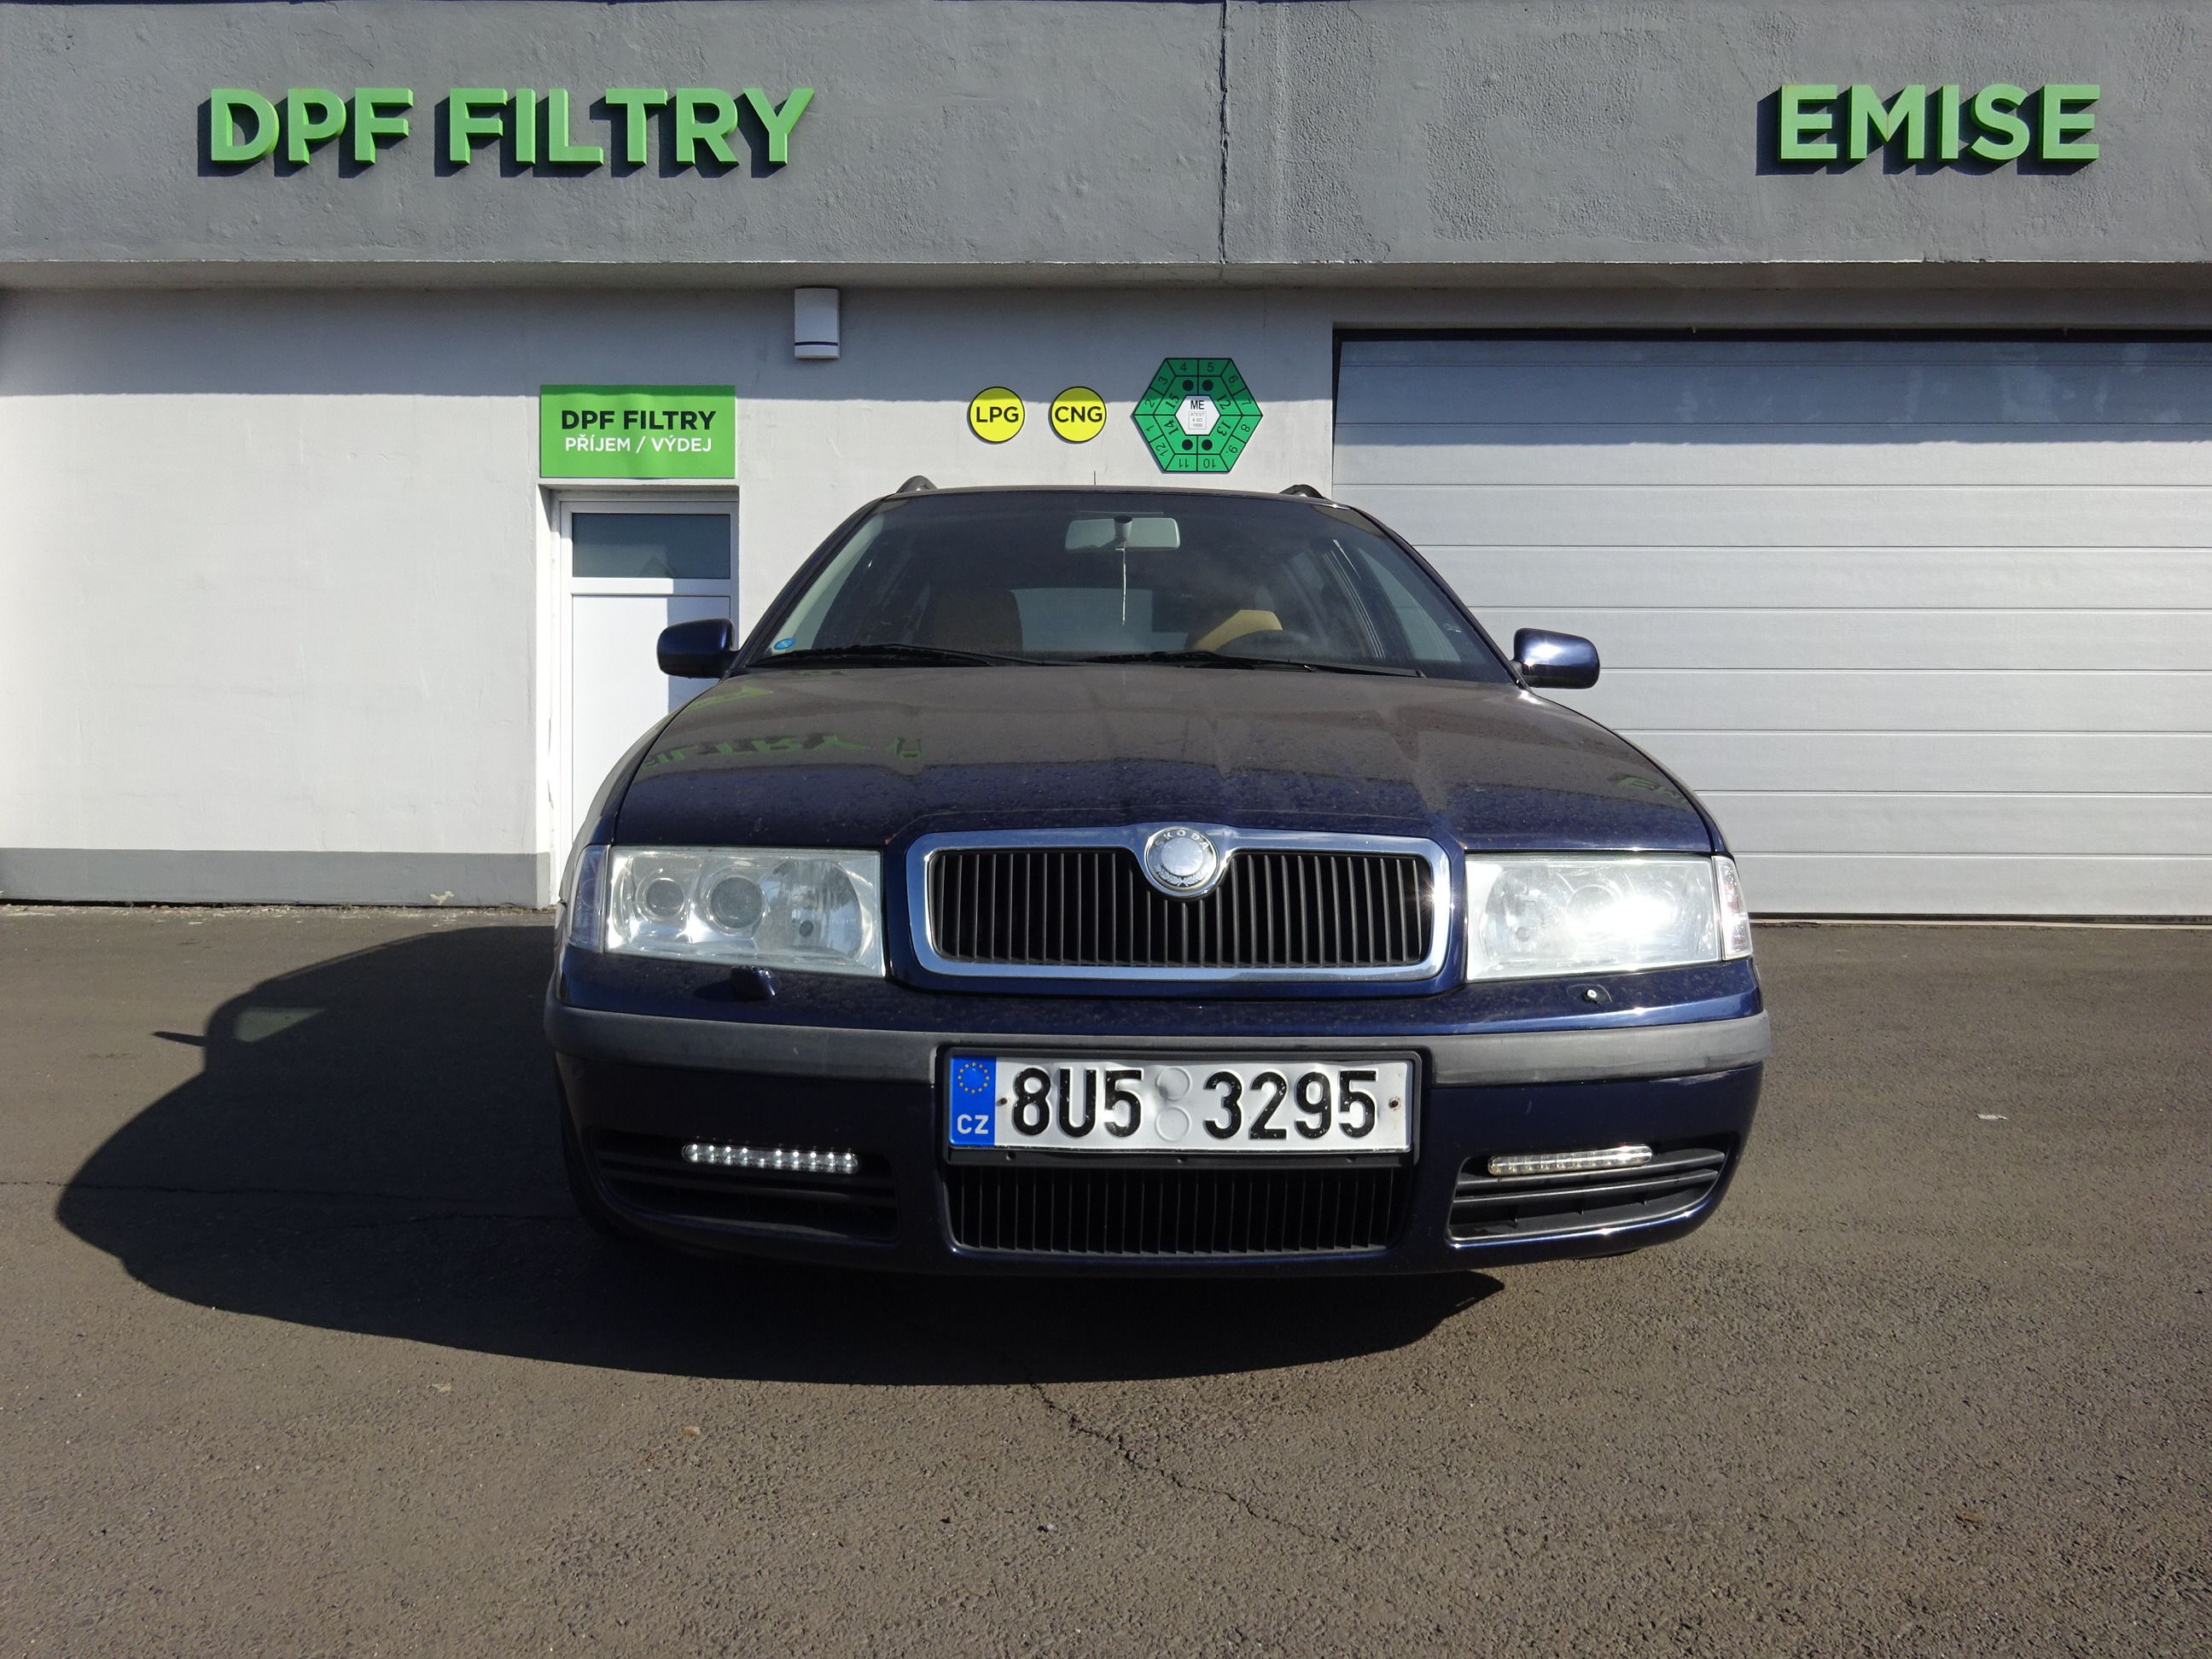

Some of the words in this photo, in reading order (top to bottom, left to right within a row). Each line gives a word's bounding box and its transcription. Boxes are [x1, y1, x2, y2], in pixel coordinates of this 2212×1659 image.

[210, 87, 413, 165] DPF
[449, 87, 815, 165] FILTRY
[1778, 84, 2101, 162] EMISE
[1180, 363, 1187, 372] 4
[1207, 362, 1214, 372] 5
[1158, 377, 1168, 386] 3
[1144, 396, 1155, 408] 2
[1165, 393, 1179, 409] 15
[1190, 400, 1205, 410] ME
[1216, 395, 1231, 410] 12
[561, 410, 615, 430] DPF
[623, 410, 716, 430] FILTRY
[975, 405, 1020, 423] LPG
[1054, 405, 1103, 423] CNG
[1164, 419, 1179, 435] 14
[1216, 421, 1231, 436] 13
[1240, 423, 1250, 433] 8
[565, 434, 631, 451] PŘÍJEM
[636, 435, 646, 454] /
[651, 434, 712, 452] VÝDEJ
[1155, 442, 1168, 457] 12
[1179, 458, 1190, 468] 11
[1203, 458, 1215, 469] 10
[1012, 1067, 1143, 1139] 8U5
[1203, 1068, 1377, 1141] 3295
[957, 1114, 989, 1135] CZ
